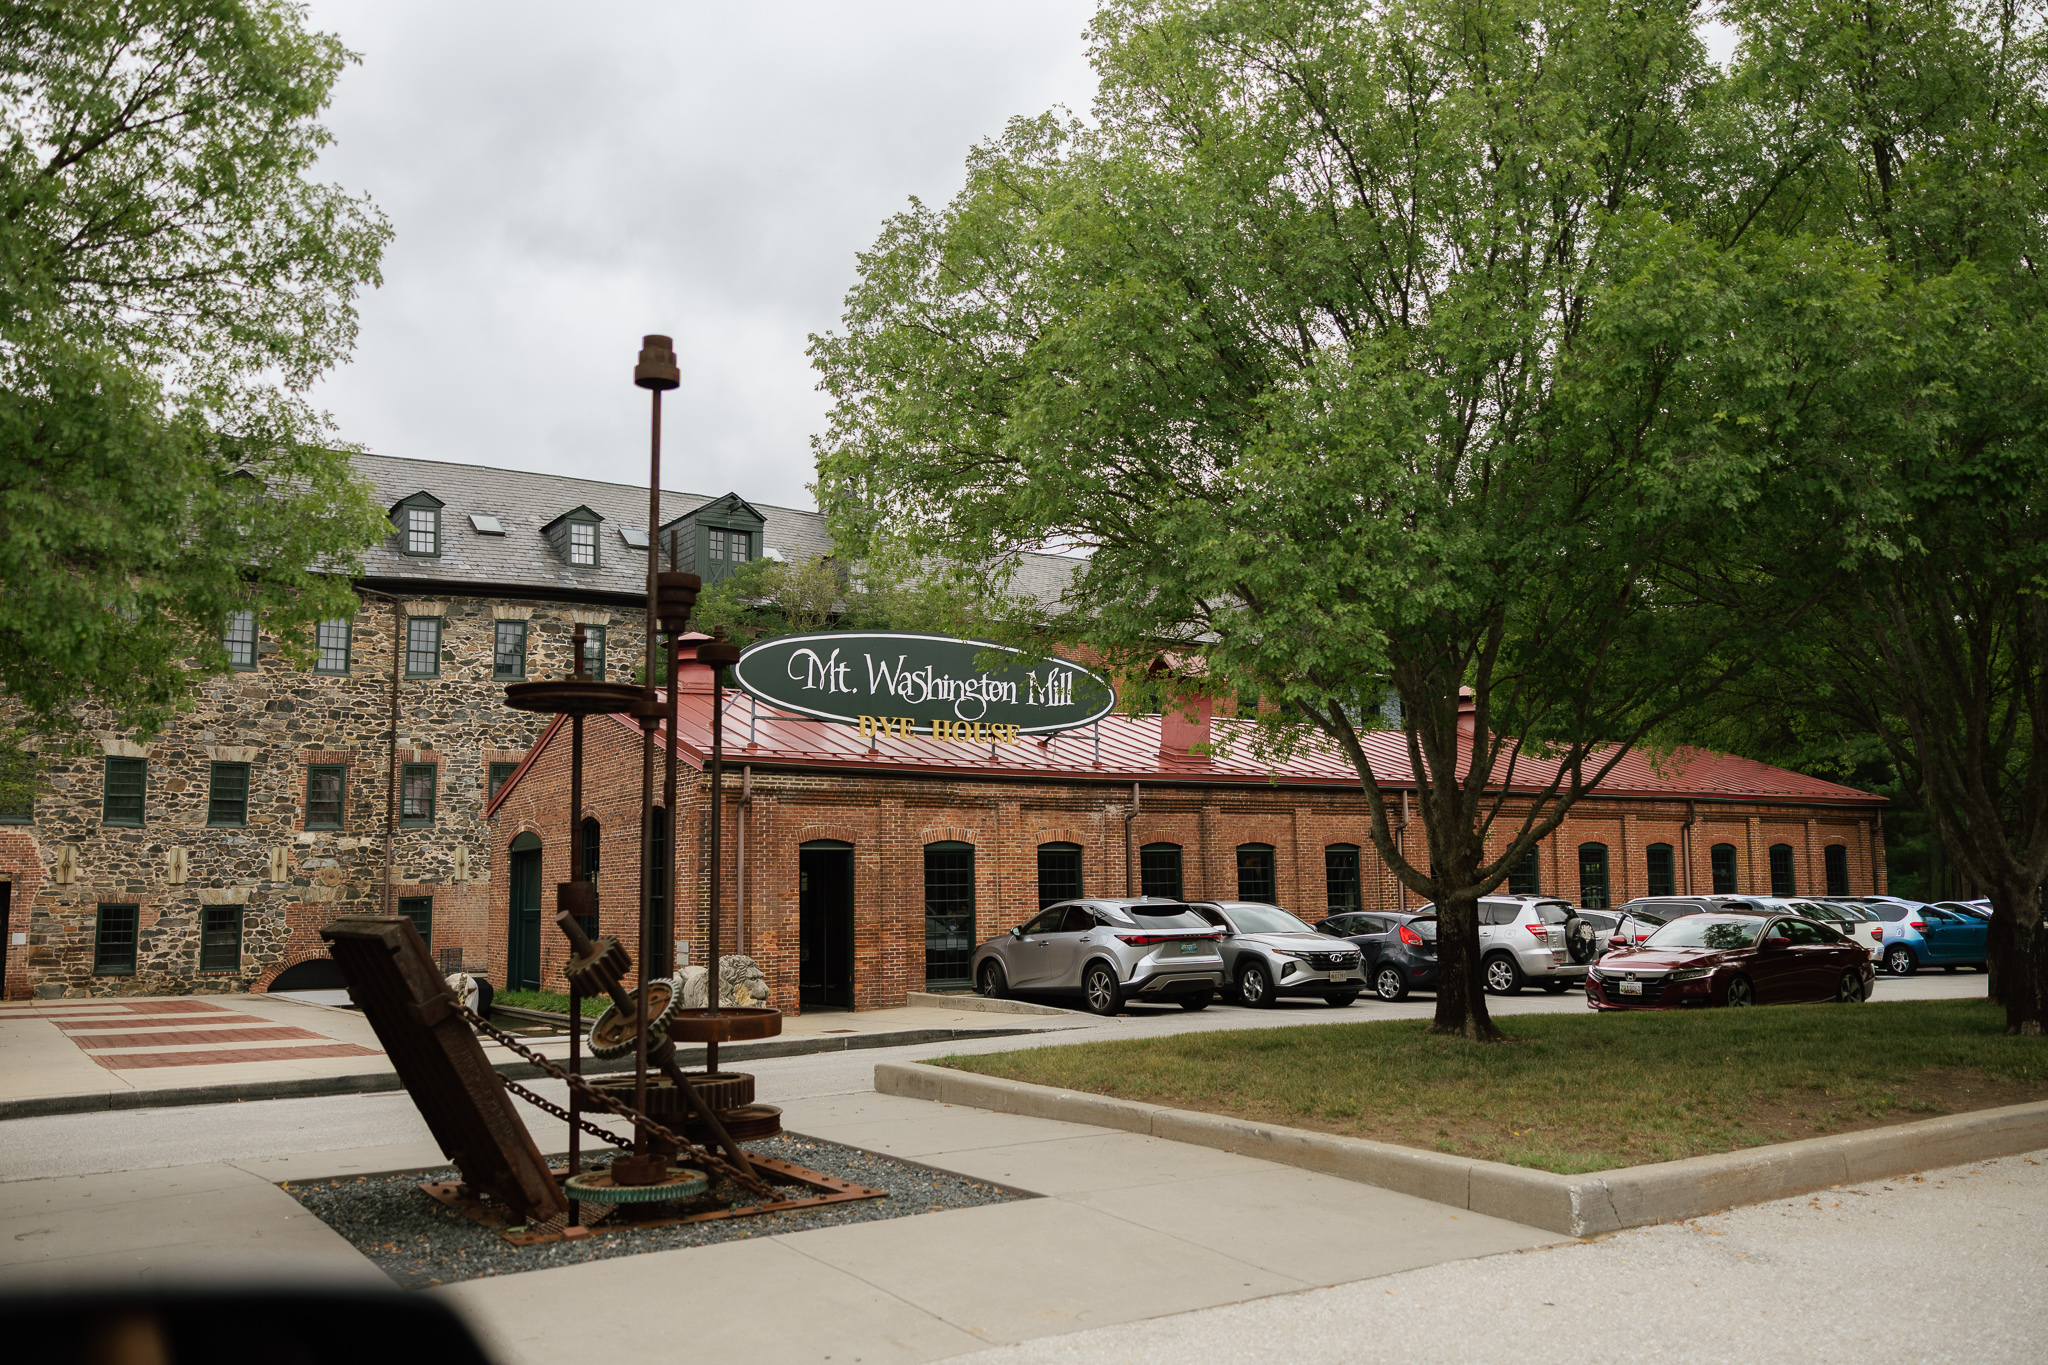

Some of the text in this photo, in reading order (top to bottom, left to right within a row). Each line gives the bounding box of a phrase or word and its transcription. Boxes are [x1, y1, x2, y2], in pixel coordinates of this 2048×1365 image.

[788, 648, 1075, 721] Mt. Washington Mill
[857, 715, 1021, 746] DYE HOUSE
